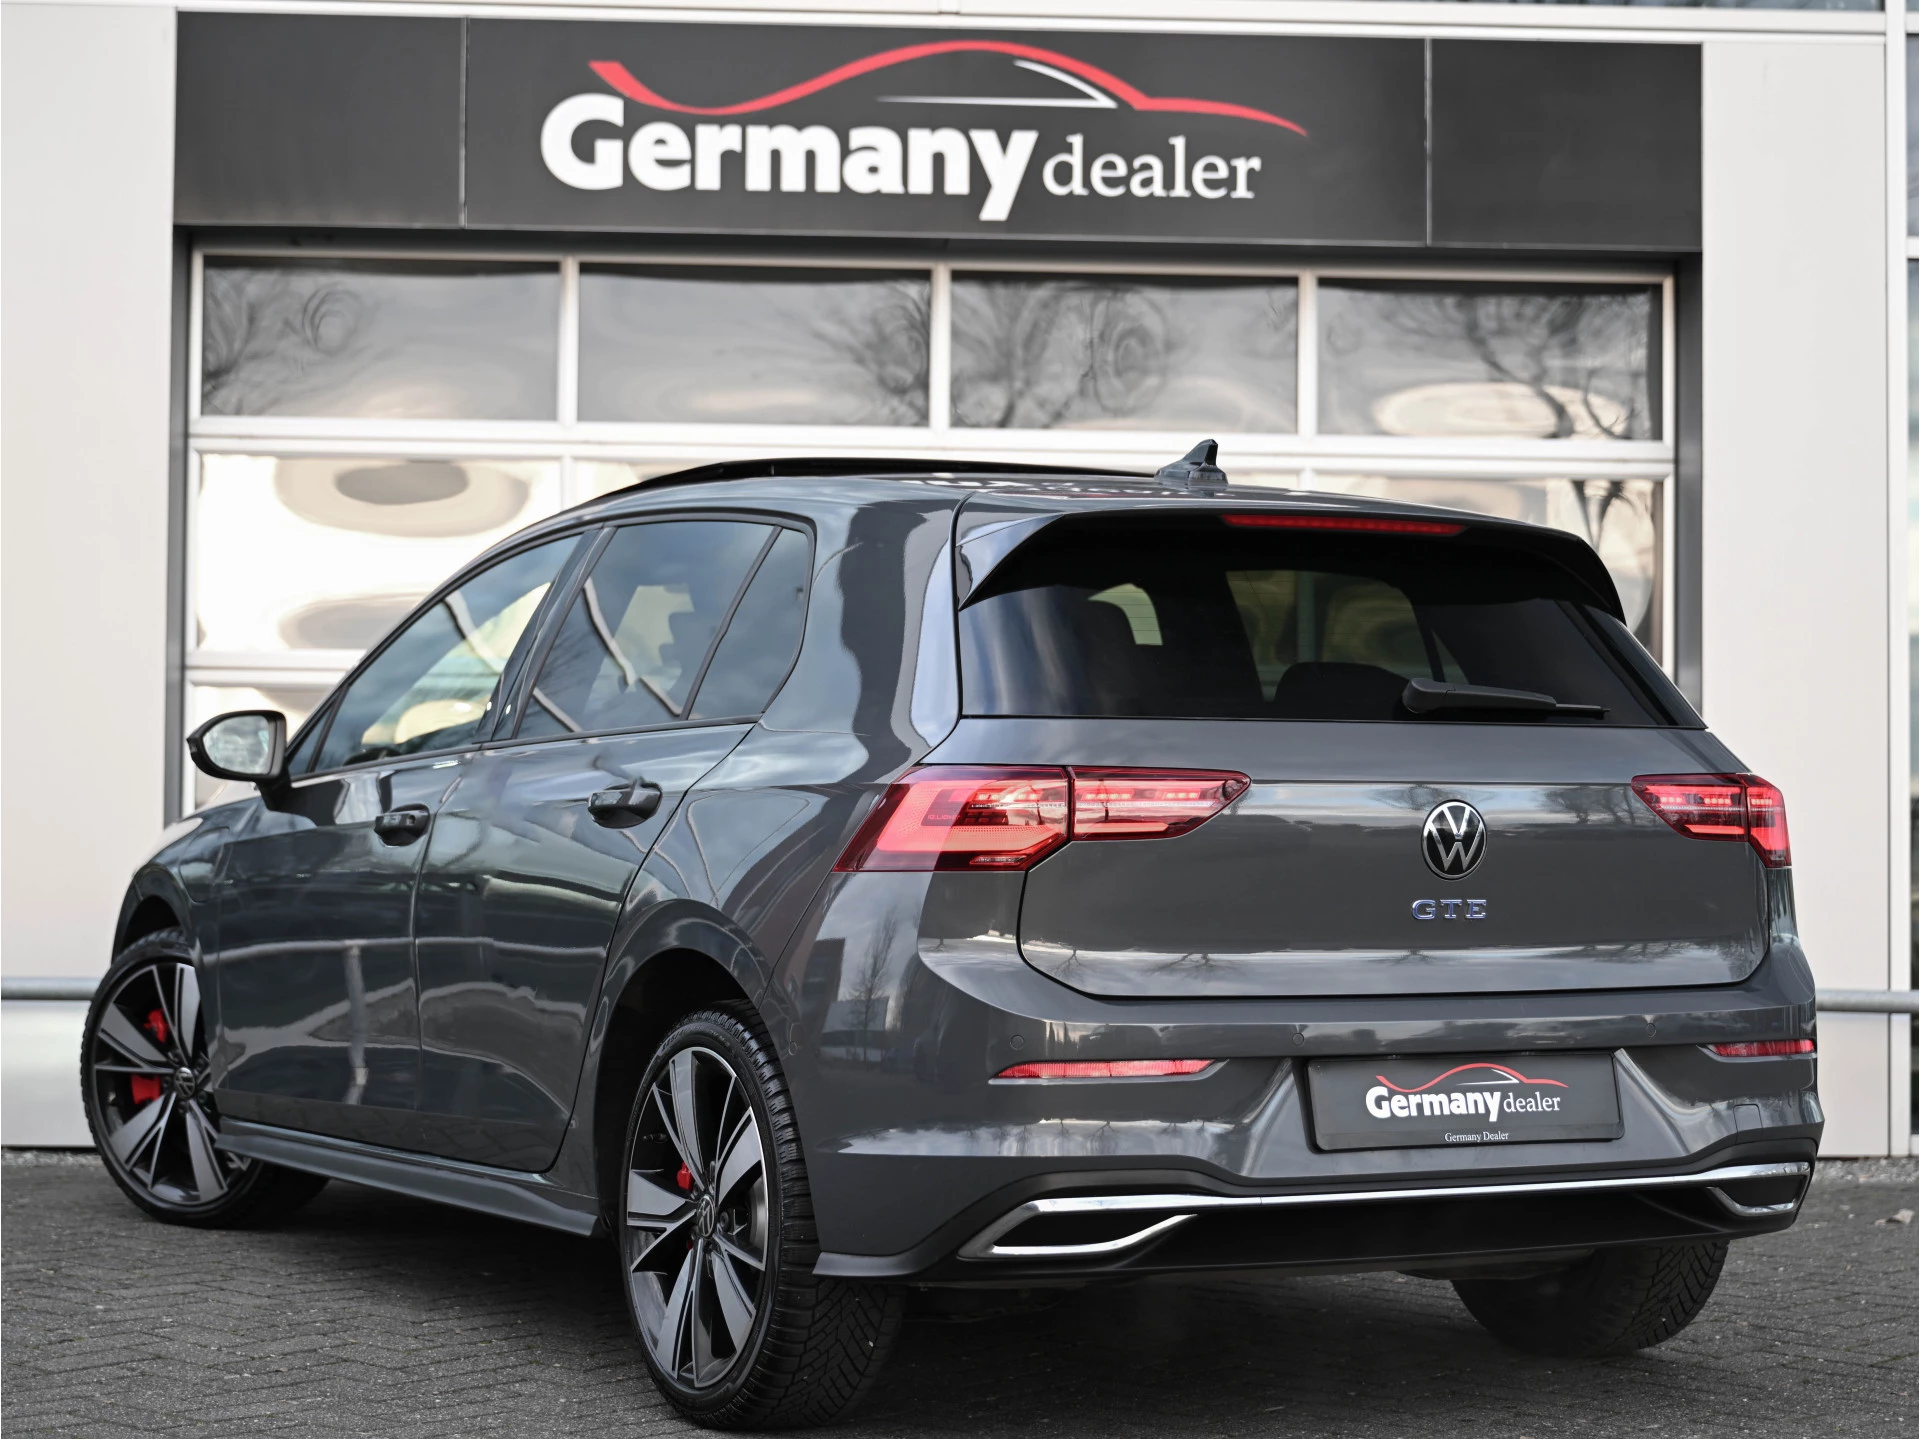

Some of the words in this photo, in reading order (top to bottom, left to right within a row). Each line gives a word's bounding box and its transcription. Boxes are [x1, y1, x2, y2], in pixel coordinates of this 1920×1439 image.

[540, 93, 1040, 221] Germany
[1042, 134, 1262, 199] dealer
[1412, 899, 1487, 919] GTE
[1365, 1086, 1501, 1122] Germany
[1503, 1092, 1561, 1112] dealer
[1444, 1132, 1481, 1142] Germany
[1482, 1130, 1509, 1140] Dealer
